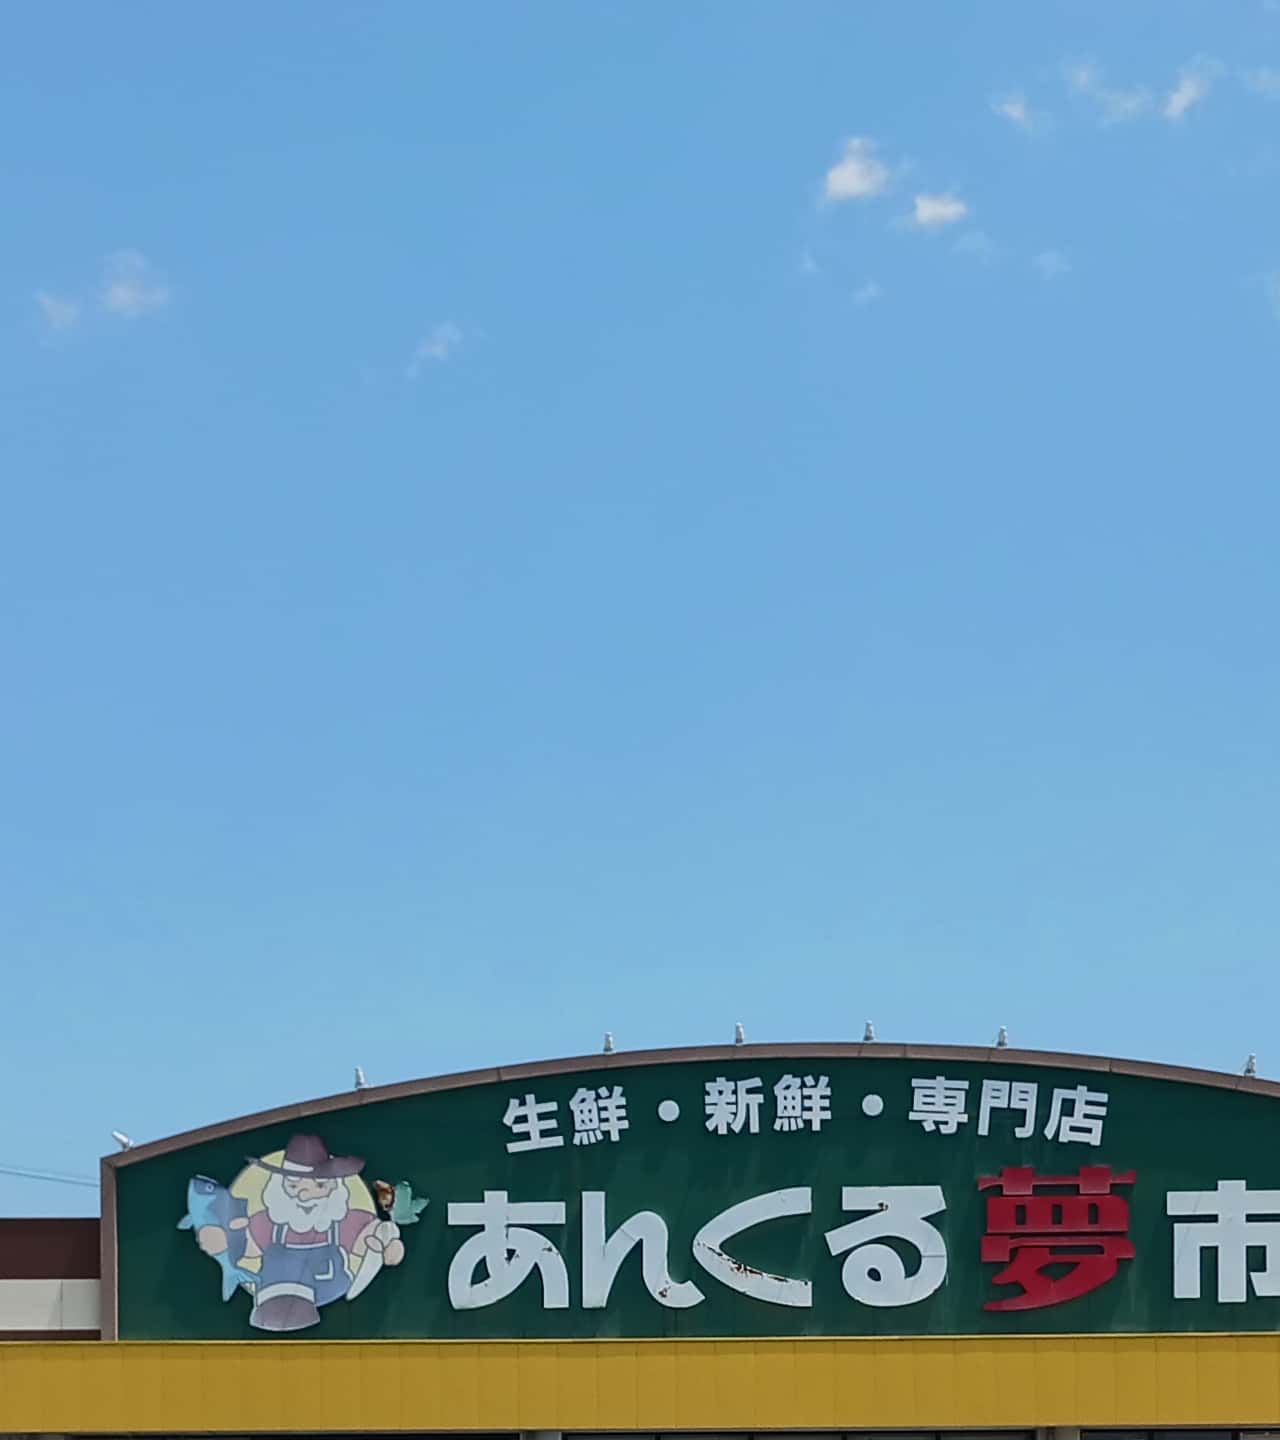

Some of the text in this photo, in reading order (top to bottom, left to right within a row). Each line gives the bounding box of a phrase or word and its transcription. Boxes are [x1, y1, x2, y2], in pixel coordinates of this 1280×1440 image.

[503, 1073, 1109, 1153] 生鮮・新鮮・専門店
